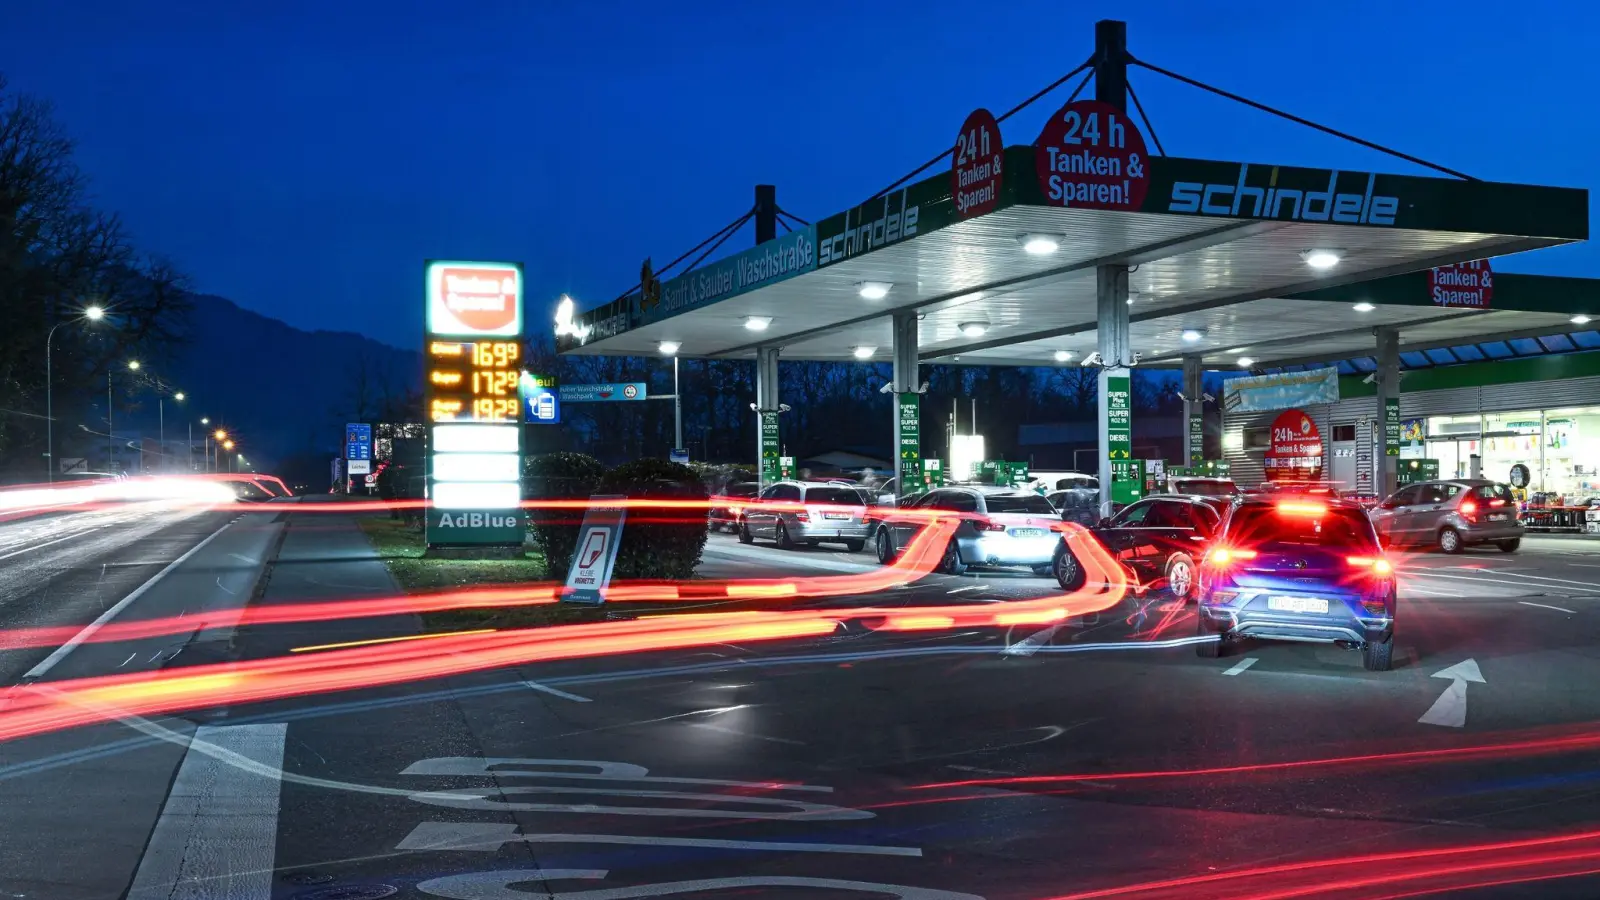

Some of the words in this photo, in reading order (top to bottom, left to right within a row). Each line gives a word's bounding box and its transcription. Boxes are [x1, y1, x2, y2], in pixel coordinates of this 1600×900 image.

[957, 132, 977, 165] 24
[980, 126, 990, 157] h
[1064, 112, 1100, 146] 24
[1109, 116, 1125, 148] h
[957, 161, 991, 187] Tanken
[993, 154, 1002, 176] &
[1047, 148, 1121, 177] Tanken
[1125, 153, 1144, 179] &
[957, 184, 995, 214] Sparen!
[1048, 175, 1130, 207] Sparen!
[1169, 163, 1399, 225] schindele
[819, 188, 919, 265] schindele
[664, 281, 689, 312] Sanft
[690, 281, 698, 304] &
[699, 269, 734, 299] Sauber
[737, 236, 813, 287] Waschstraße
[1432, 266, 1478, 287] Tanken
[1481, 270, 1493, 288] &
[1433, 286, 1484, 307] Sparen!
[1274, 427, 1287, 442] 24
[1287, 427, 1293, 442] h
[1275, 445, 1293, 453] Tanken
[1293, 444, 1298, 453] &
[438, 512, 517, 529] AdBlue
